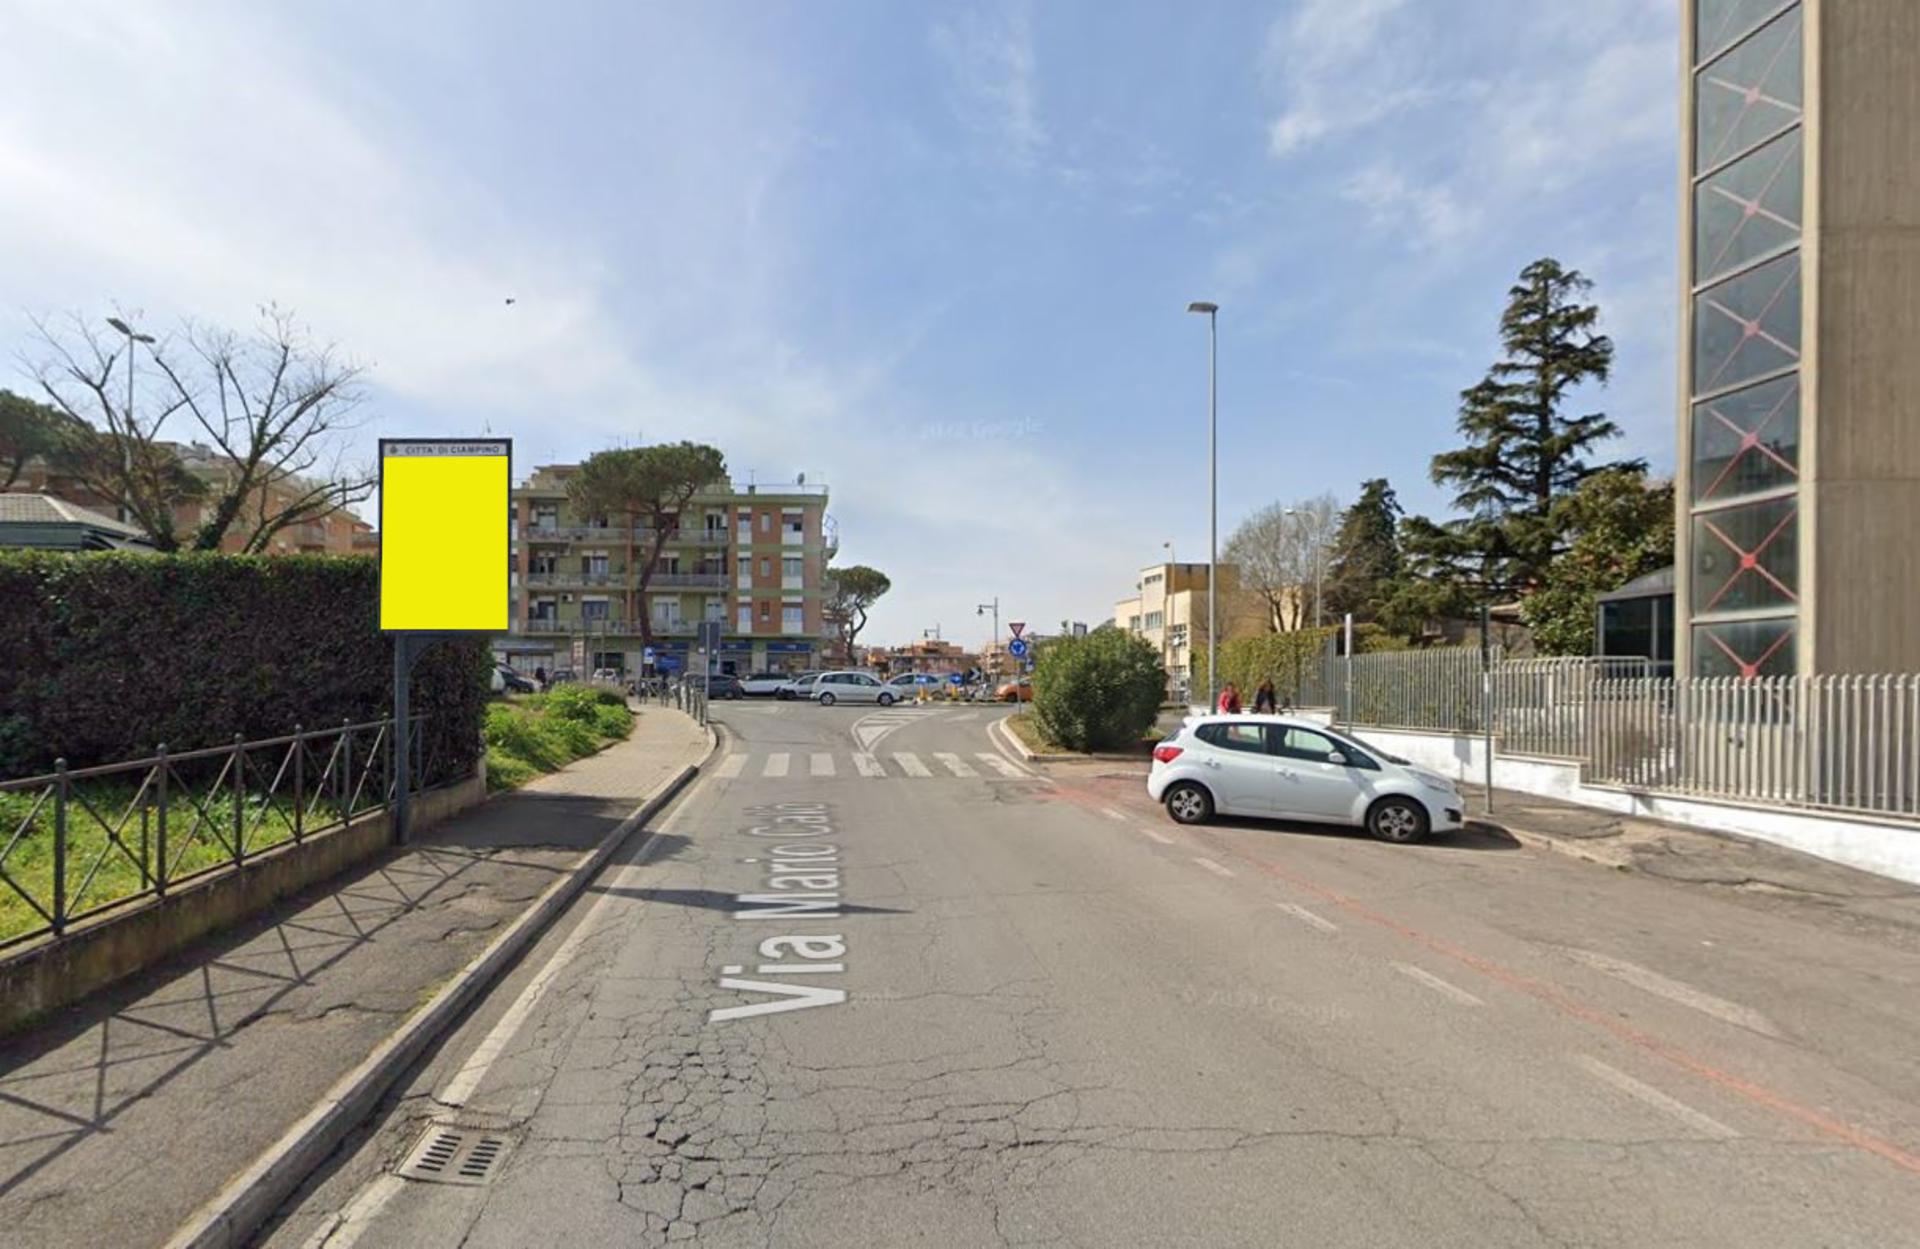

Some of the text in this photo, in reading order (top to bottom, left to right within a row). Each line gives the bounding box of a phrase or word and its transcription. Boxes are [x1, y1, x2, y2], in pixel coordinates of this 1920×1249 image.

[405, 444, 500, 455] CITTA' DI CIAMPINO
